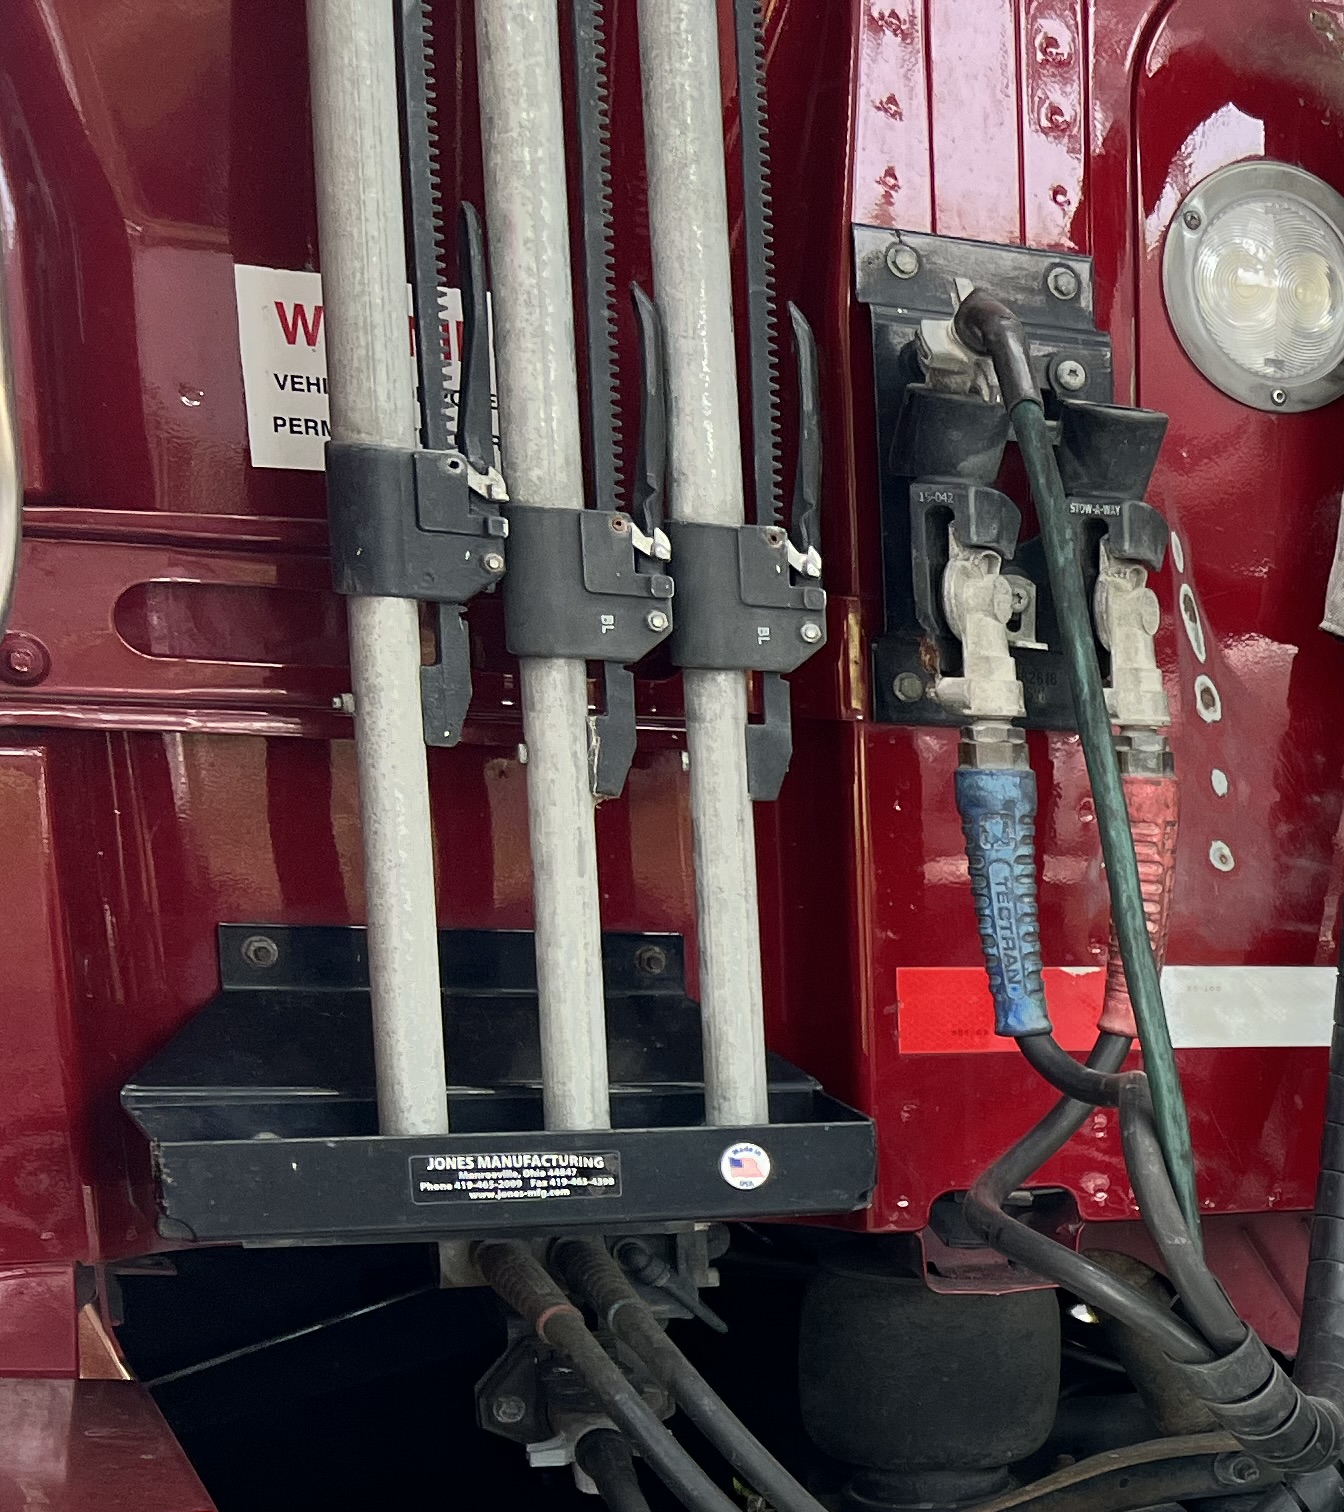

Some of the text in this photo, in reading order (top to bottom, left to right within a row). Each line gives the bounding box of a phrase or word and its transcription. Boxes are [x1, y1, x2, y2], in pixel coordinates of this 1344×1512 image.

[273, 373, 329, 394] VEHI
[919, 491, 954, 503] 15-042
[1070, 502, 1120, 516] STOW-A-WAY
[994, 875, 1022, 985] TECTRAN
[426, 1154, 604, 1170] JONES MANUFACTURING
[522, 1169, 546, 1178] Ohio
[420, 1181, 453, 1191] Phone
[529, 1178, 548, 1187] Fax
